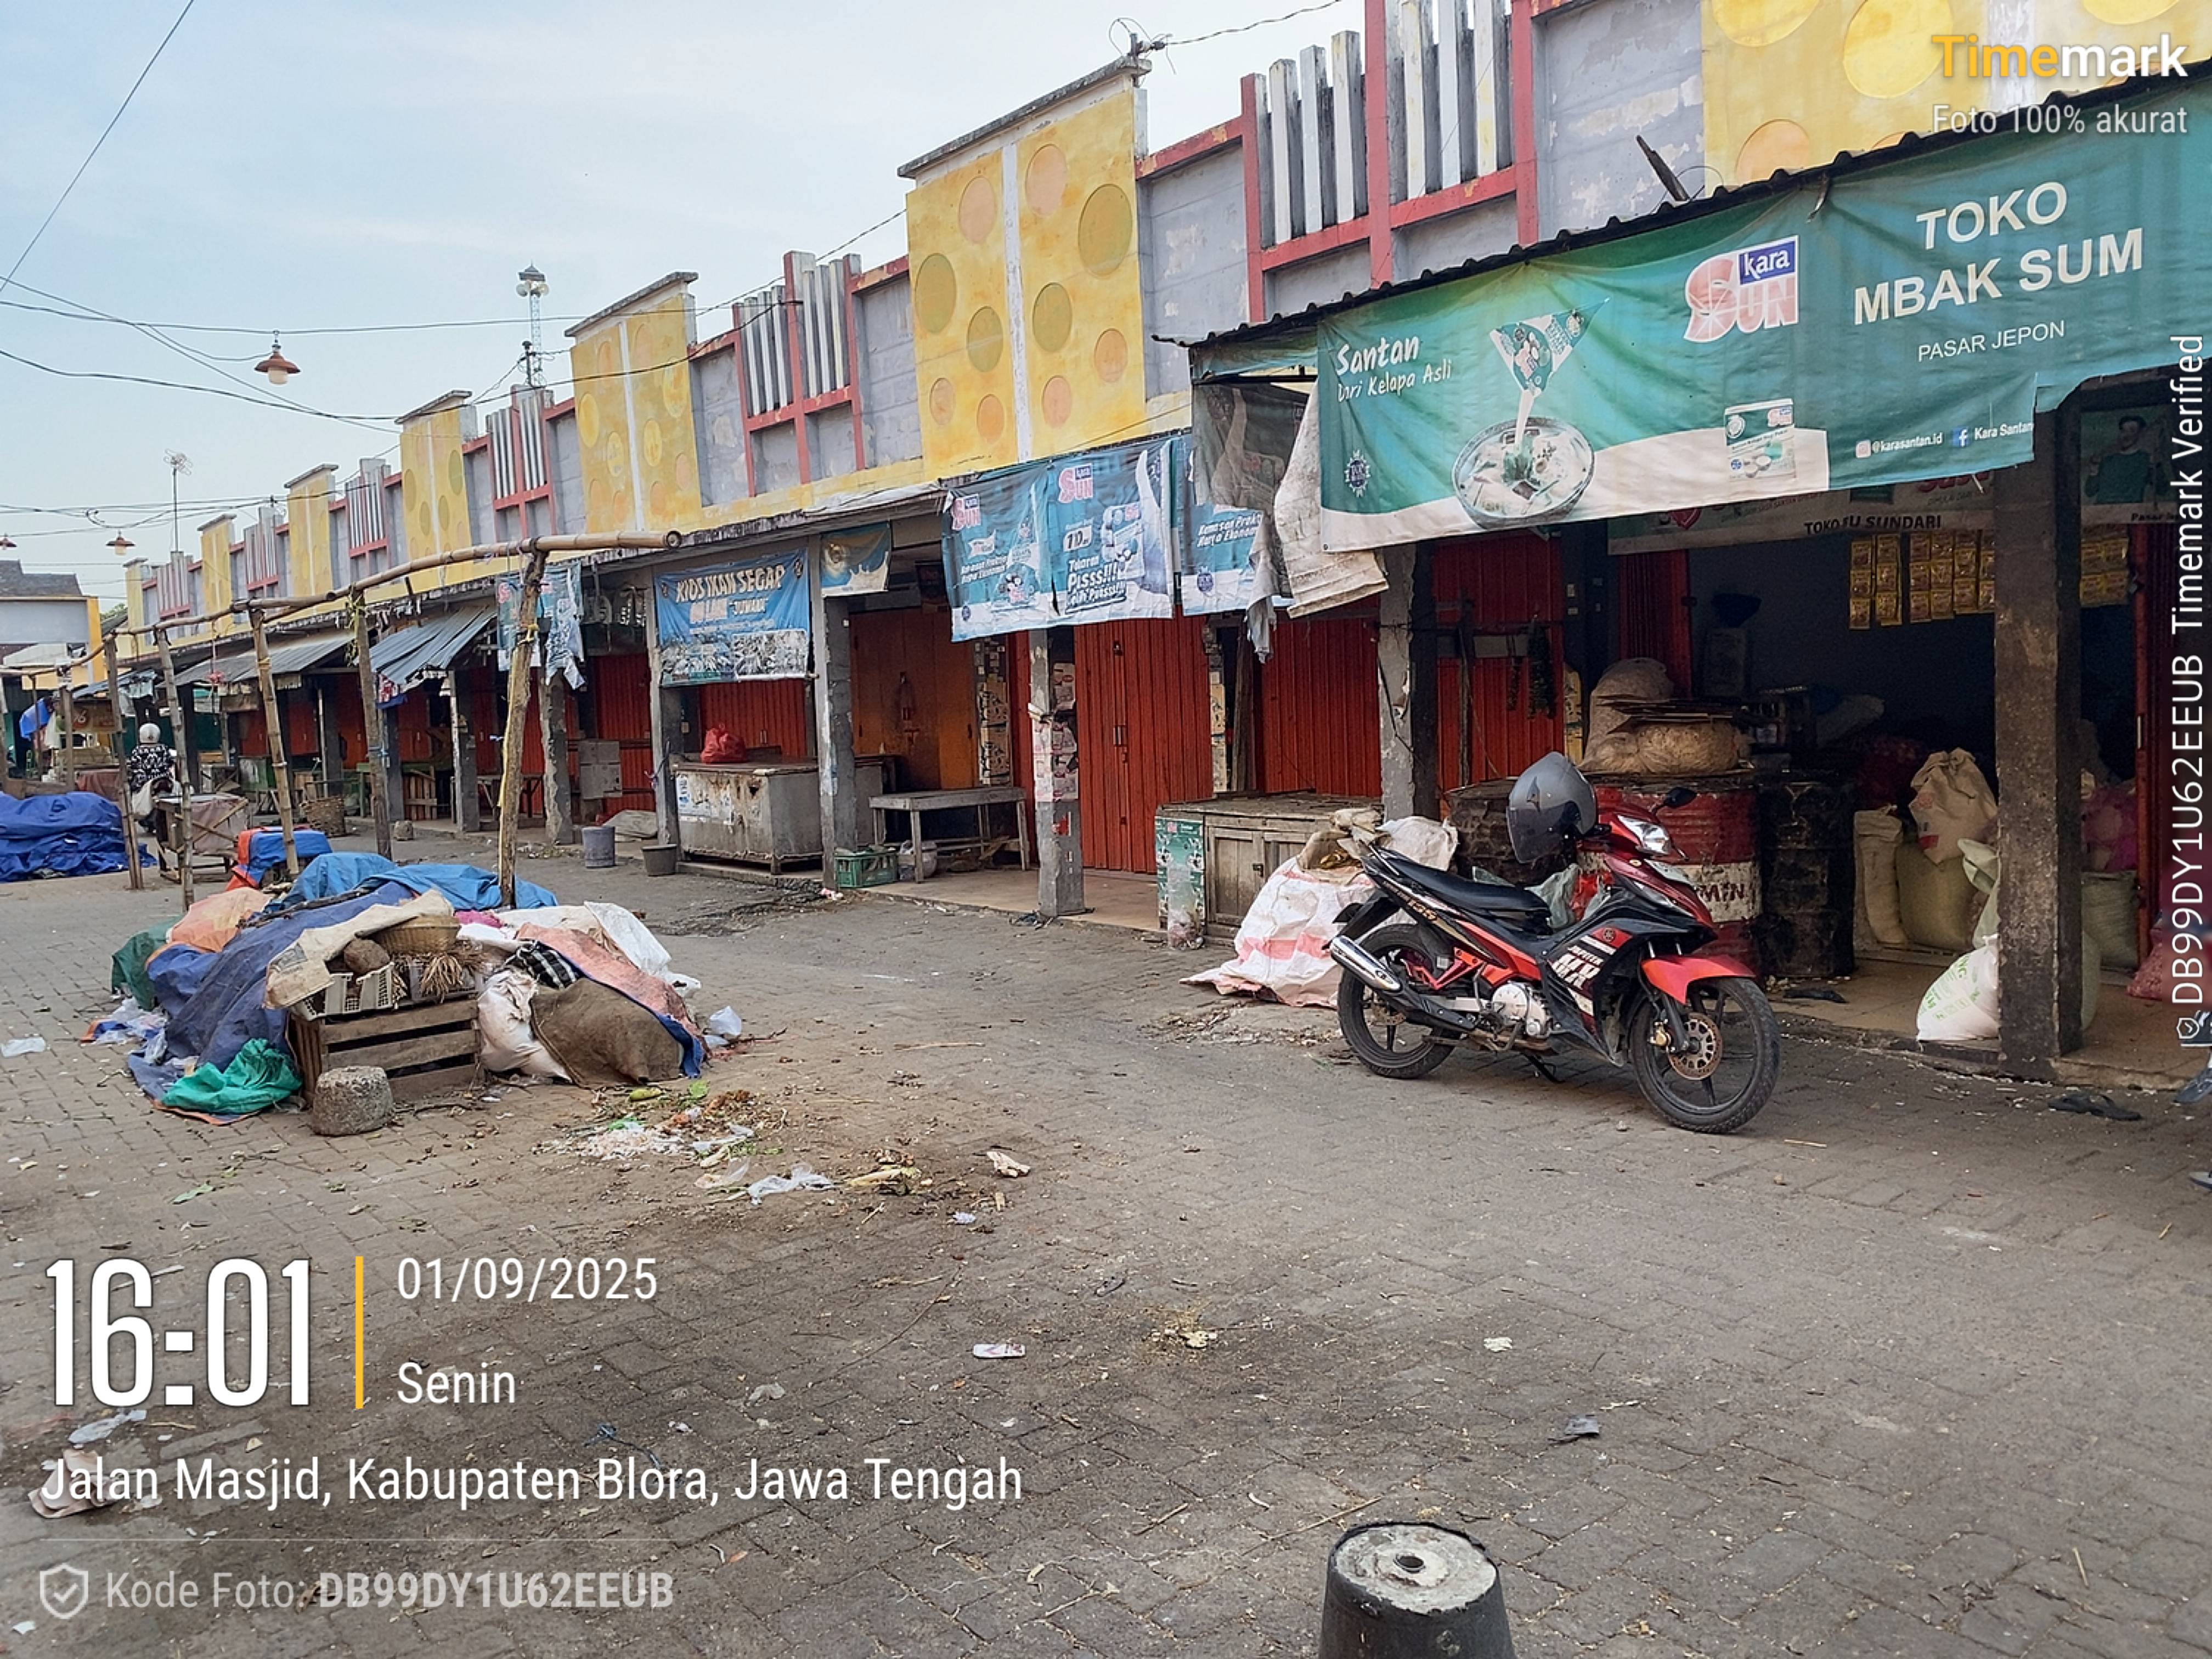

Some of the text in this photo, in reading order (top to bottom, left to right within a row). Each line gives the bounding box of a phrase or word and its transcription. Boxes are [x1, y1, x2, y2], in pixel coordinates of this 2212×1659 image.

[1916, 182, 2068, 250] TOKO
[1743, 249, 1791, 279] kara
[1854, 227, 2143, 325] MBAK SUM
[1336, 336, 1420, 376] Santan
[1918, 321, 2065, 362] PASAR JEPON
[1338, 359, 1452, 402] Dari Kelapa Asli
[1975, 427, 1997, 440] Kara
[1804, 518, 1838, 535] TOKO
[1865, 514, 1942, 529] SUNDARI
